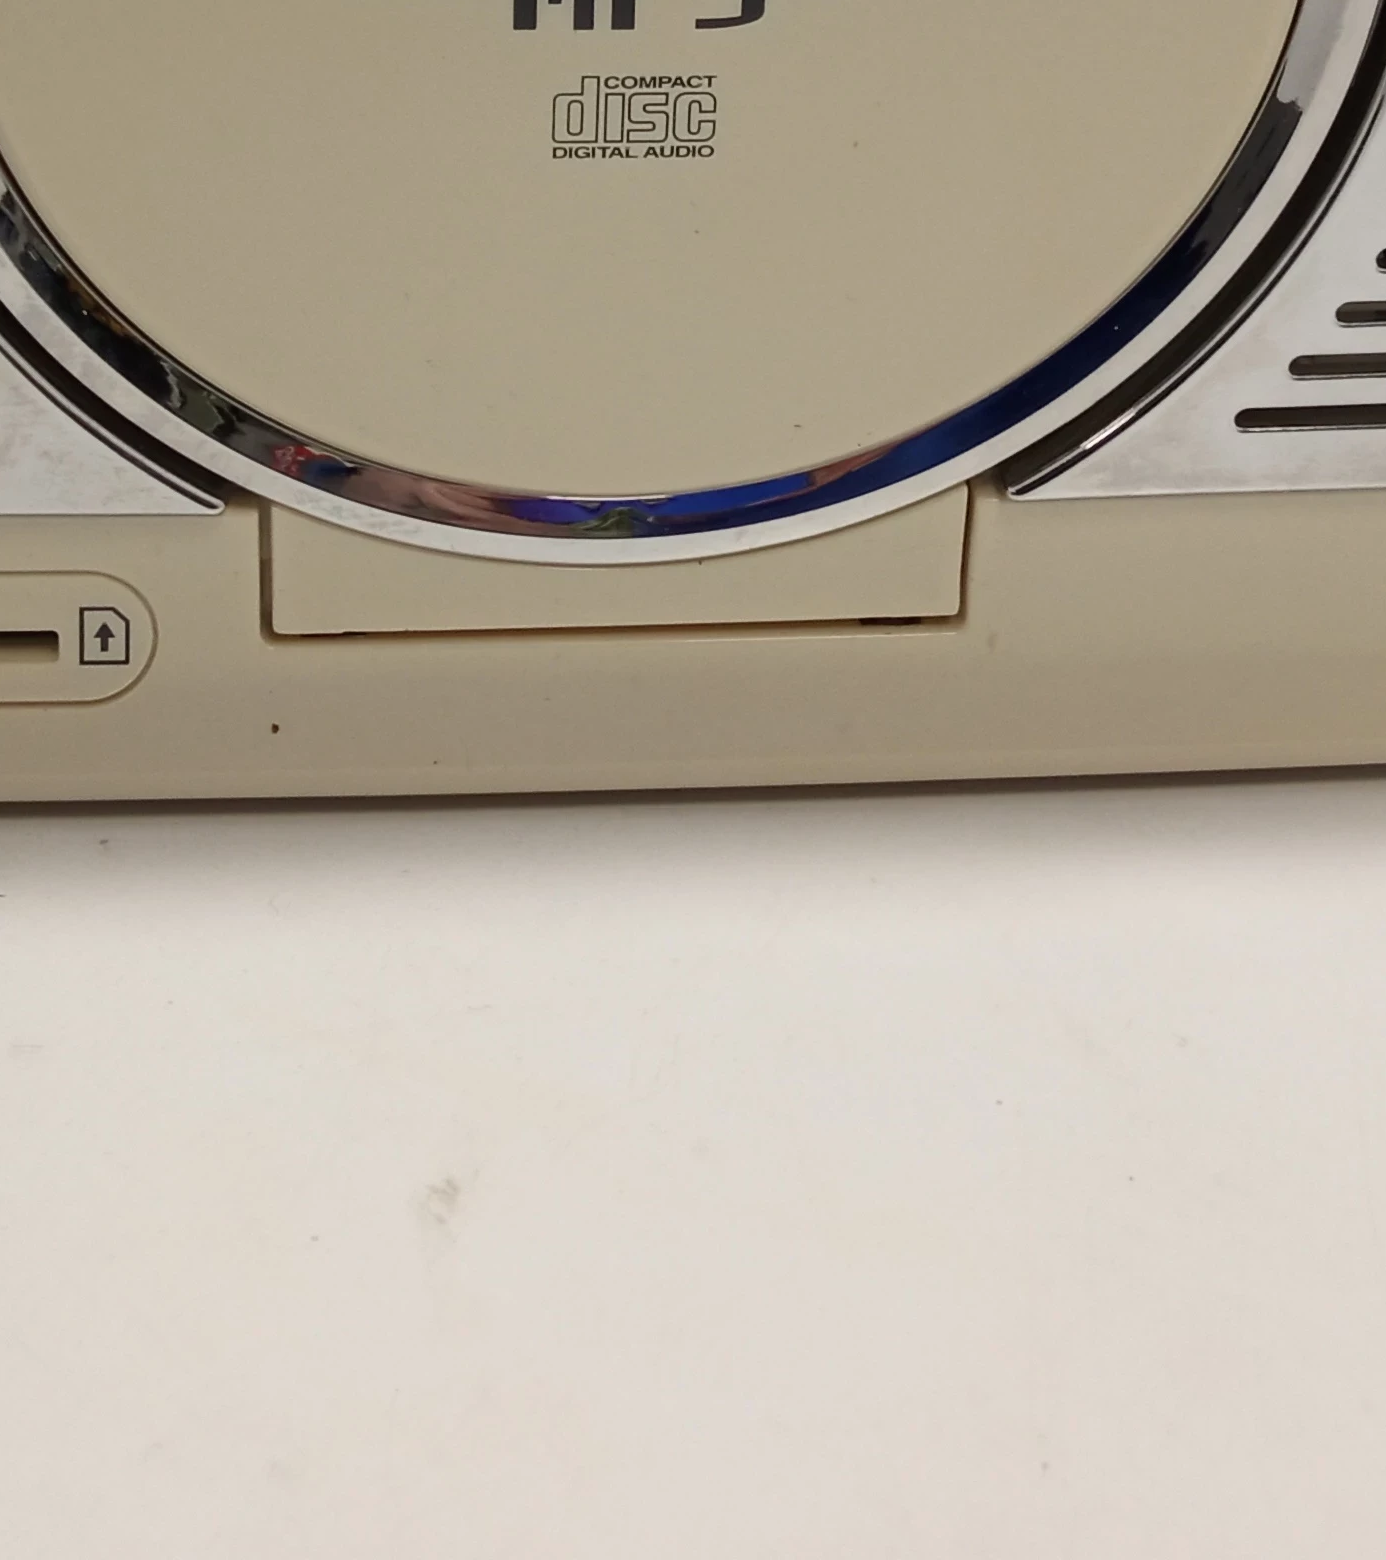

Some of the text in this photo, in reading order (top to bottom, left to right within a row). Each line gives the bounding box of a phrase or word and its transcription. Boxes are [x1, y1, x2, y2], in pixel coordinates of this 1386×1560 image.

[603, 75, 717, 89] COMPACT
[551, 75, 717, 143] disc
[552, 145, 715, 159] DIGITAL AUDIO
